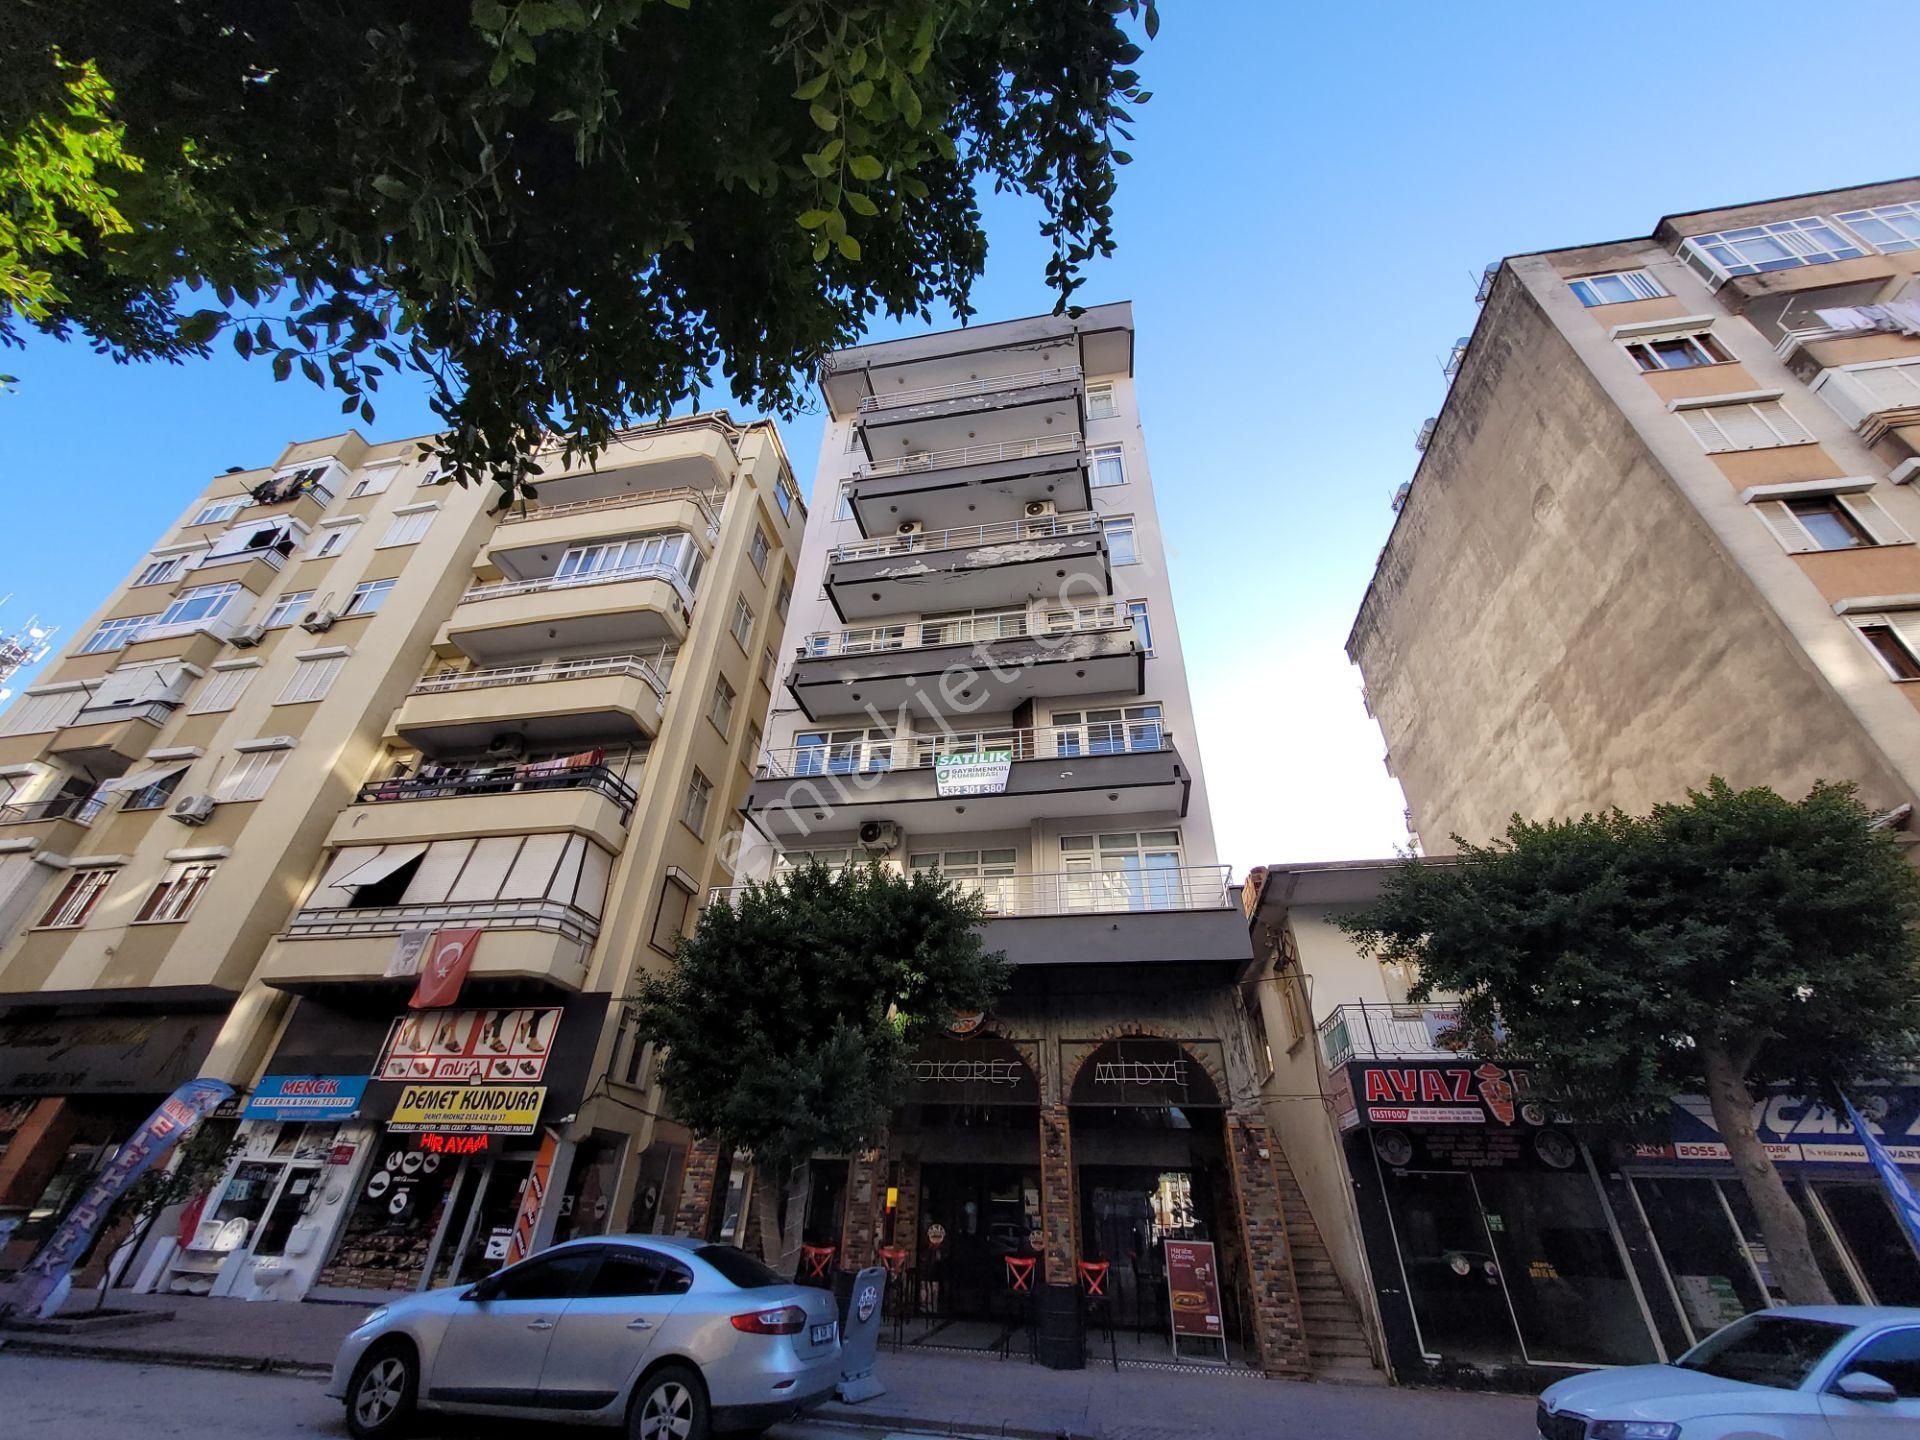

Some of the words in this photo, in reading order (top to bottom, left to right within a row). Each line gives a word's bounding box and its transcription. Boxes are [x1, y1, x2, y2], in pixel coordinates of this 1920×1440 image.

[939, 752, 1009, 766] SATILIK
[963, 784, 981, 795] 301
[914, 1058, 1022, 1088] OKOREÇ
[1094, 1056, 1189, 1087] MİDYE
[1364, 1069, 1480, 1102] AYAZ
[402, 1089, 459, 1110] DEMET
[460, 1090, 540, 1111] KUNDURA
[1371, 1109, 1408, 1120] FASTFOOD
[1679, 1145, 1718, 1157] BOSS
